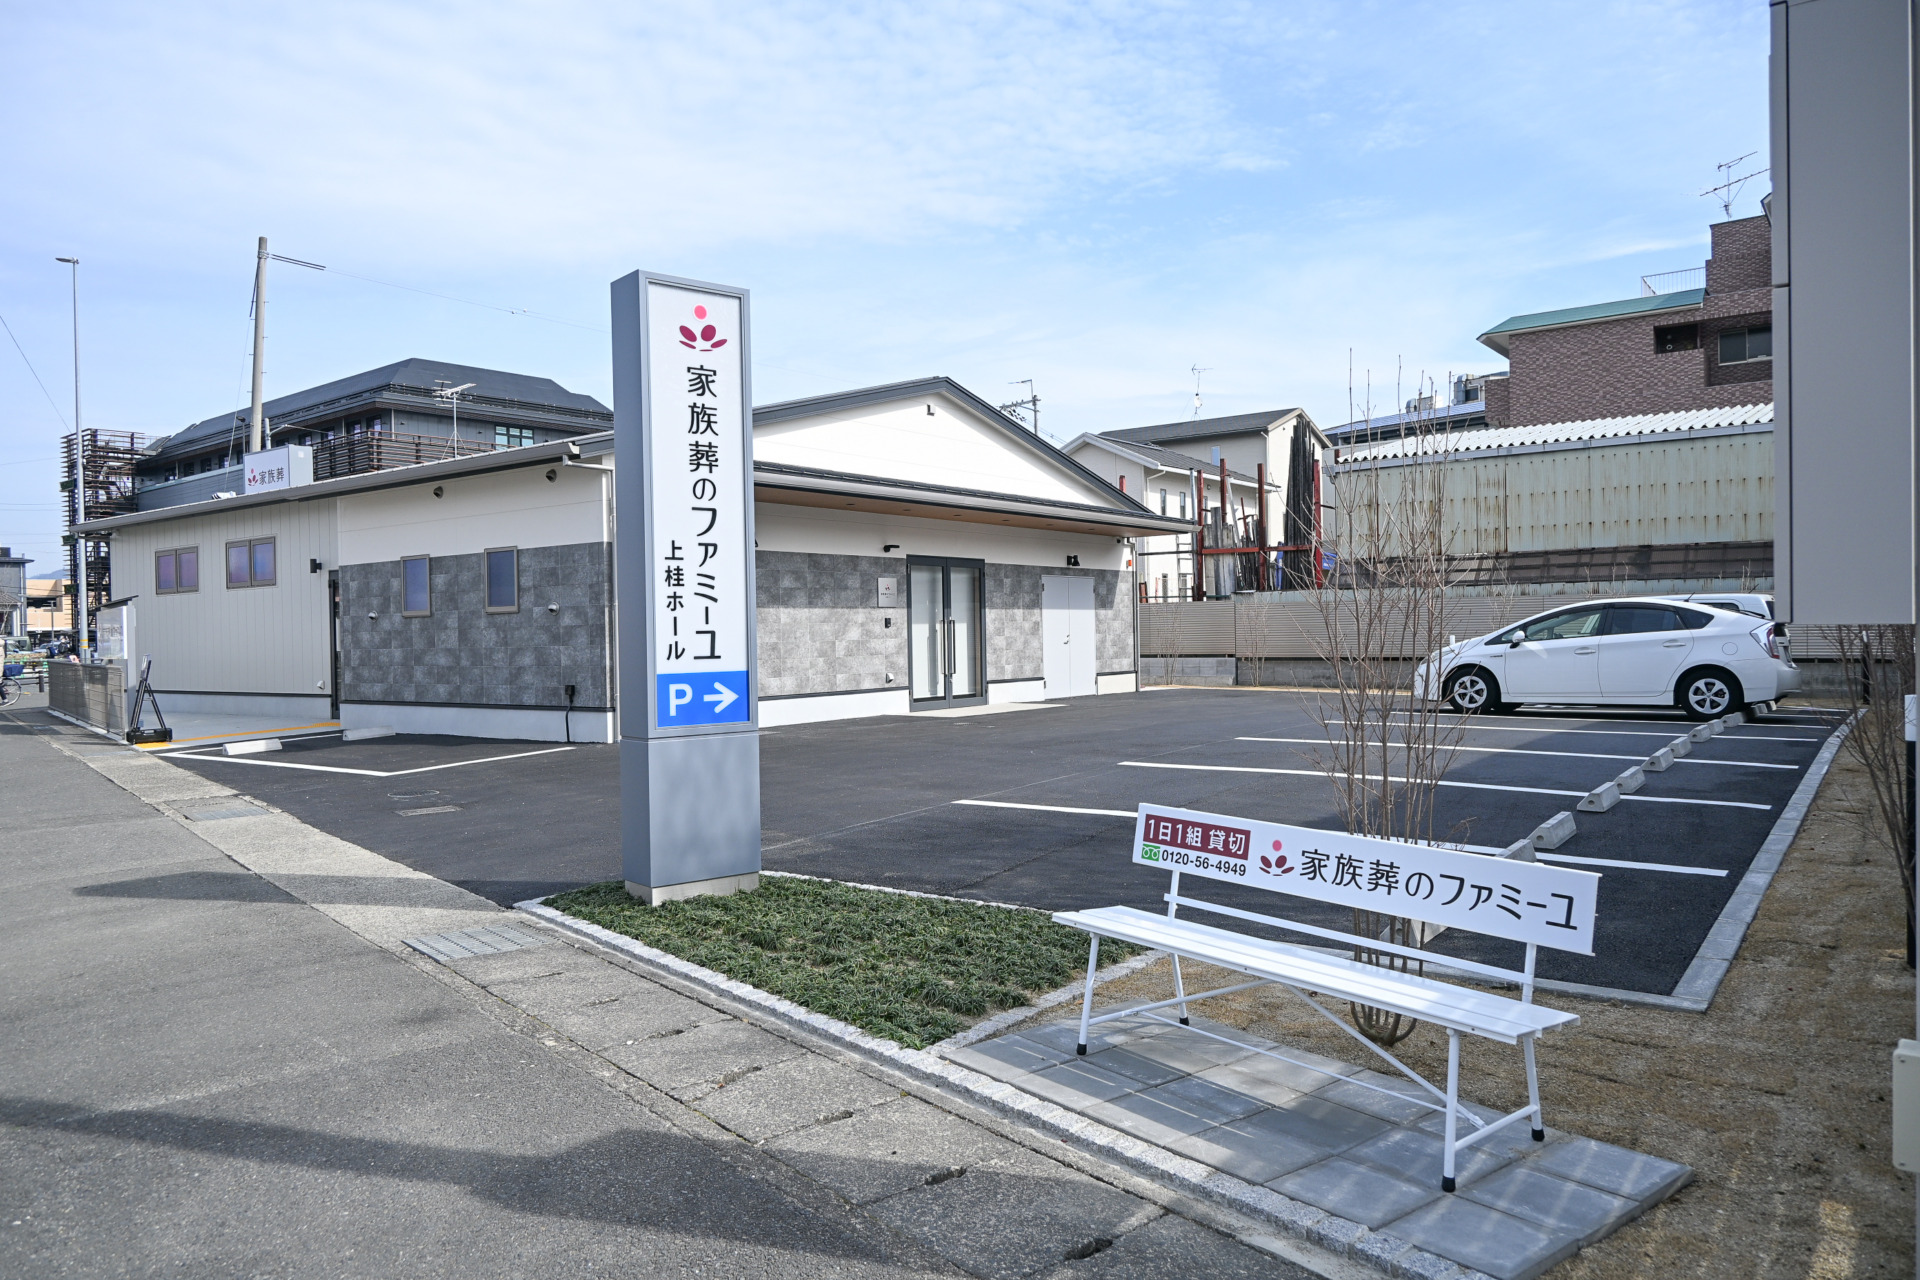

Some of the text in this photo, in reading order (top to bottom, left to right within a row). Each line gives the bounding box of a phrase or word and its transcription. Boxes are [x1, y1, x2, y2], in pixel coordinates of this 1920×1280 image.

[259, 467, 284, 485] 家族葬
[687, 365, 721, 660] 家族葬のファミーユ
[664, 540, 686, 661] 上桂ホール
[669, 683, 693, 716] P
[1148, 819, 1246, 855] 1日1組 貸切
[1161, 850, 1247, 876] 0120-56-4949
[1300, 848, 1578, 931] 家族葬のファミーユ
